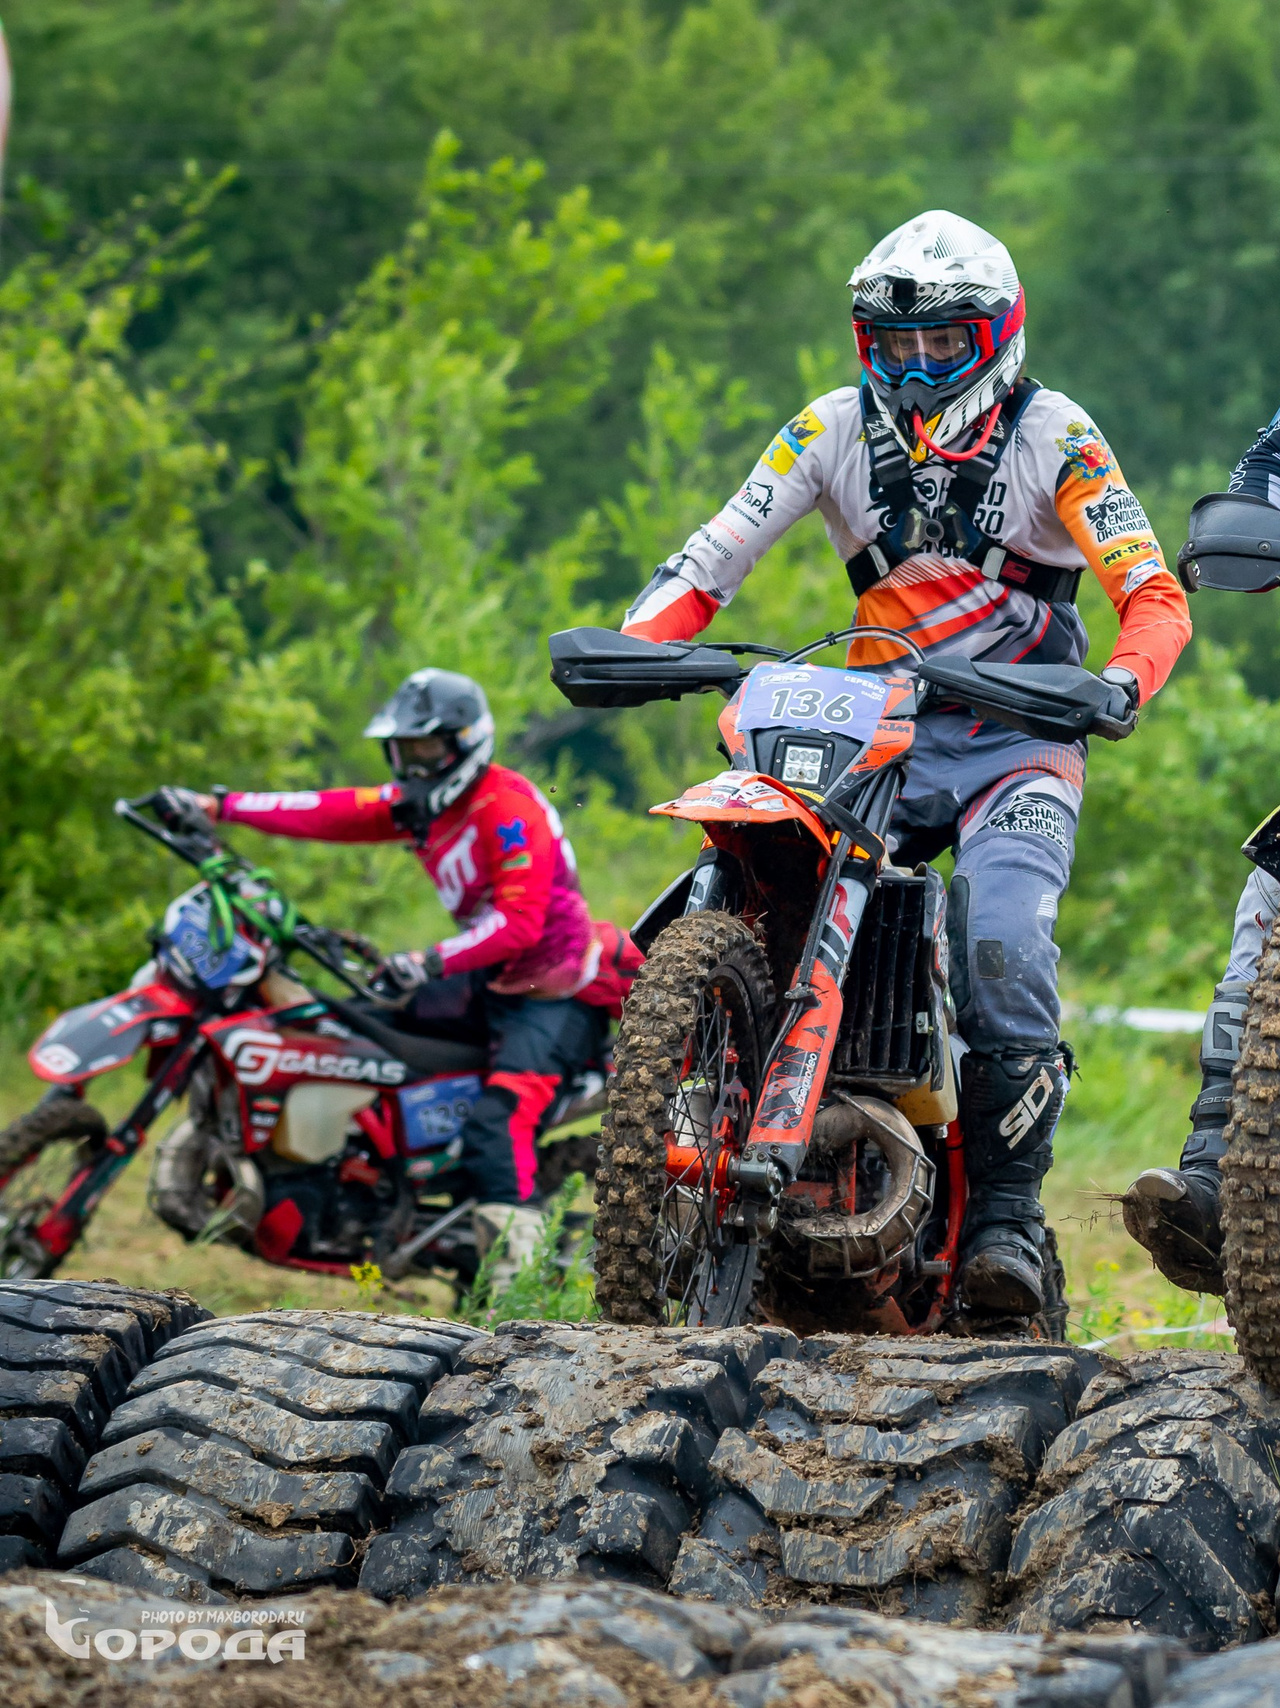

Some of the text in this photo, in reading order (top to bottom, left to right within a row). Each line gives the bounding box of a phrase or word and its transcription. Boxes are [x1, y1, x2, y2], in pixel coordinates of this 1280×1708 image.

[844, 675, 886, 694] СЕРЕБРО
[769, 688, 855, 724] 136
[877, 723, 911, 733] KTM
[277, 1050, 406, 1084] GASGAS
[795, 1052, 818, 1116] erzbergrodeo
